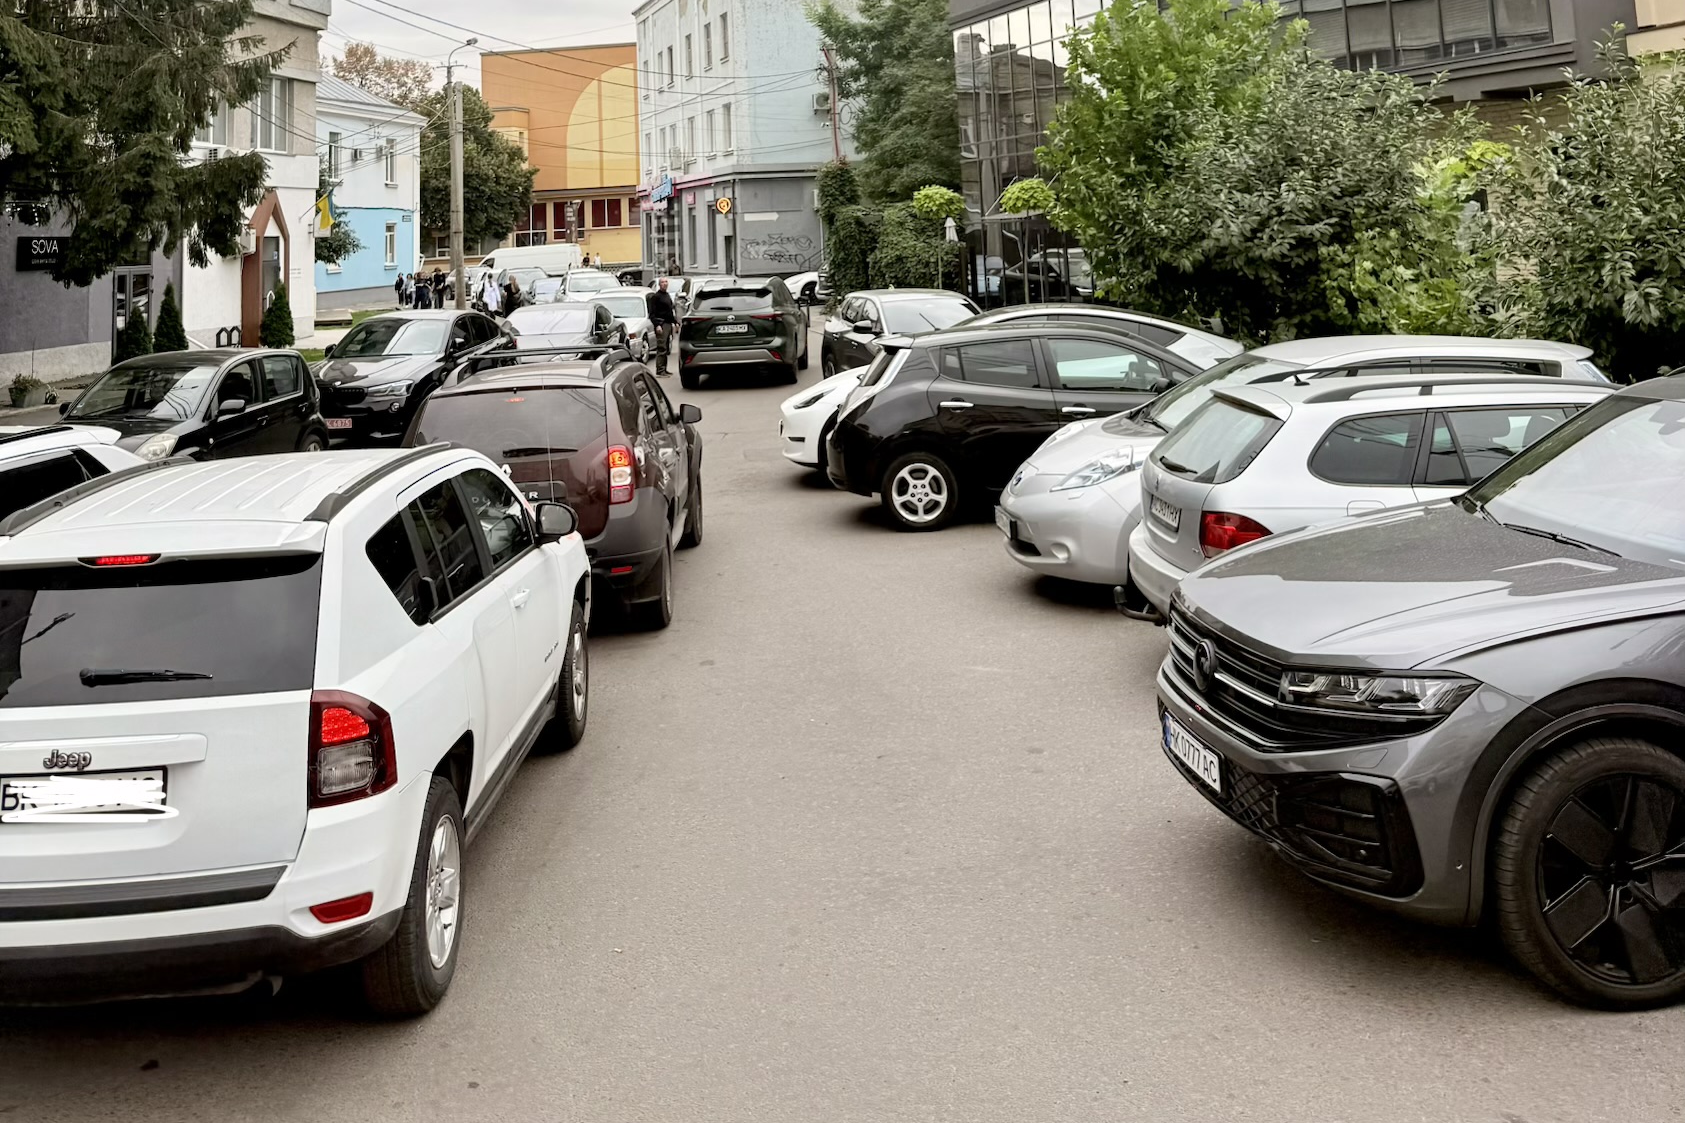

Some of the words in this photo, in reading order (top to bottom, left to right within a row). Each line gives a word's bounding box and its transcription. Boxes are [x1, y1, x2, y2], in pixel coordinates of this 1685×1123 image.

[31, 239, 59, 254] SOVA
[43, 749, 92, 770] Jeep
[1202, 754, 1217, 783] AC
